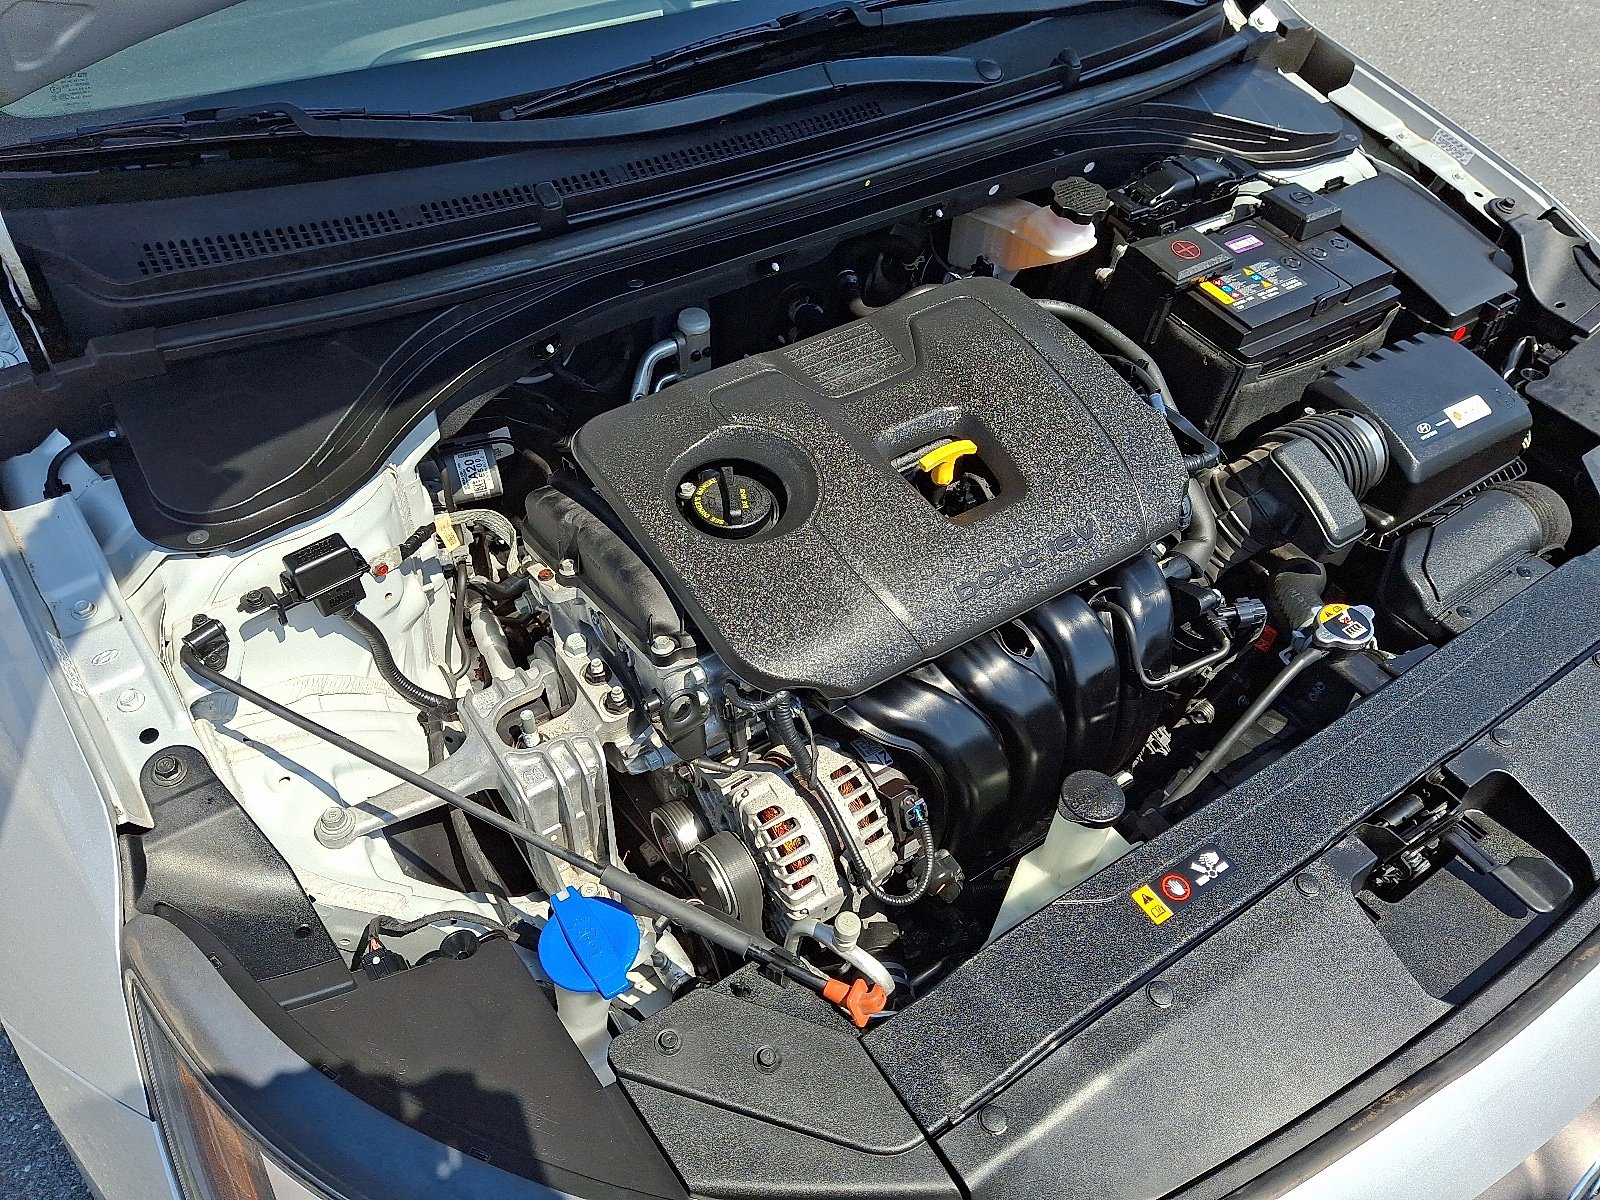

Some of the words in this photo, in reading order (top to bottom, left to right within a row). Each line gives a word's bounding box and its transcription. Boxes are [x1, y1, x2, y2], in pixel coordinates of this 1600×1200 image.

[464, 459, 478, 479] A20
[710, 516, 725, 525] SEE
[954, 549, 1042, 603] DOHC
[1046, 519, 1095, 556] 16V
